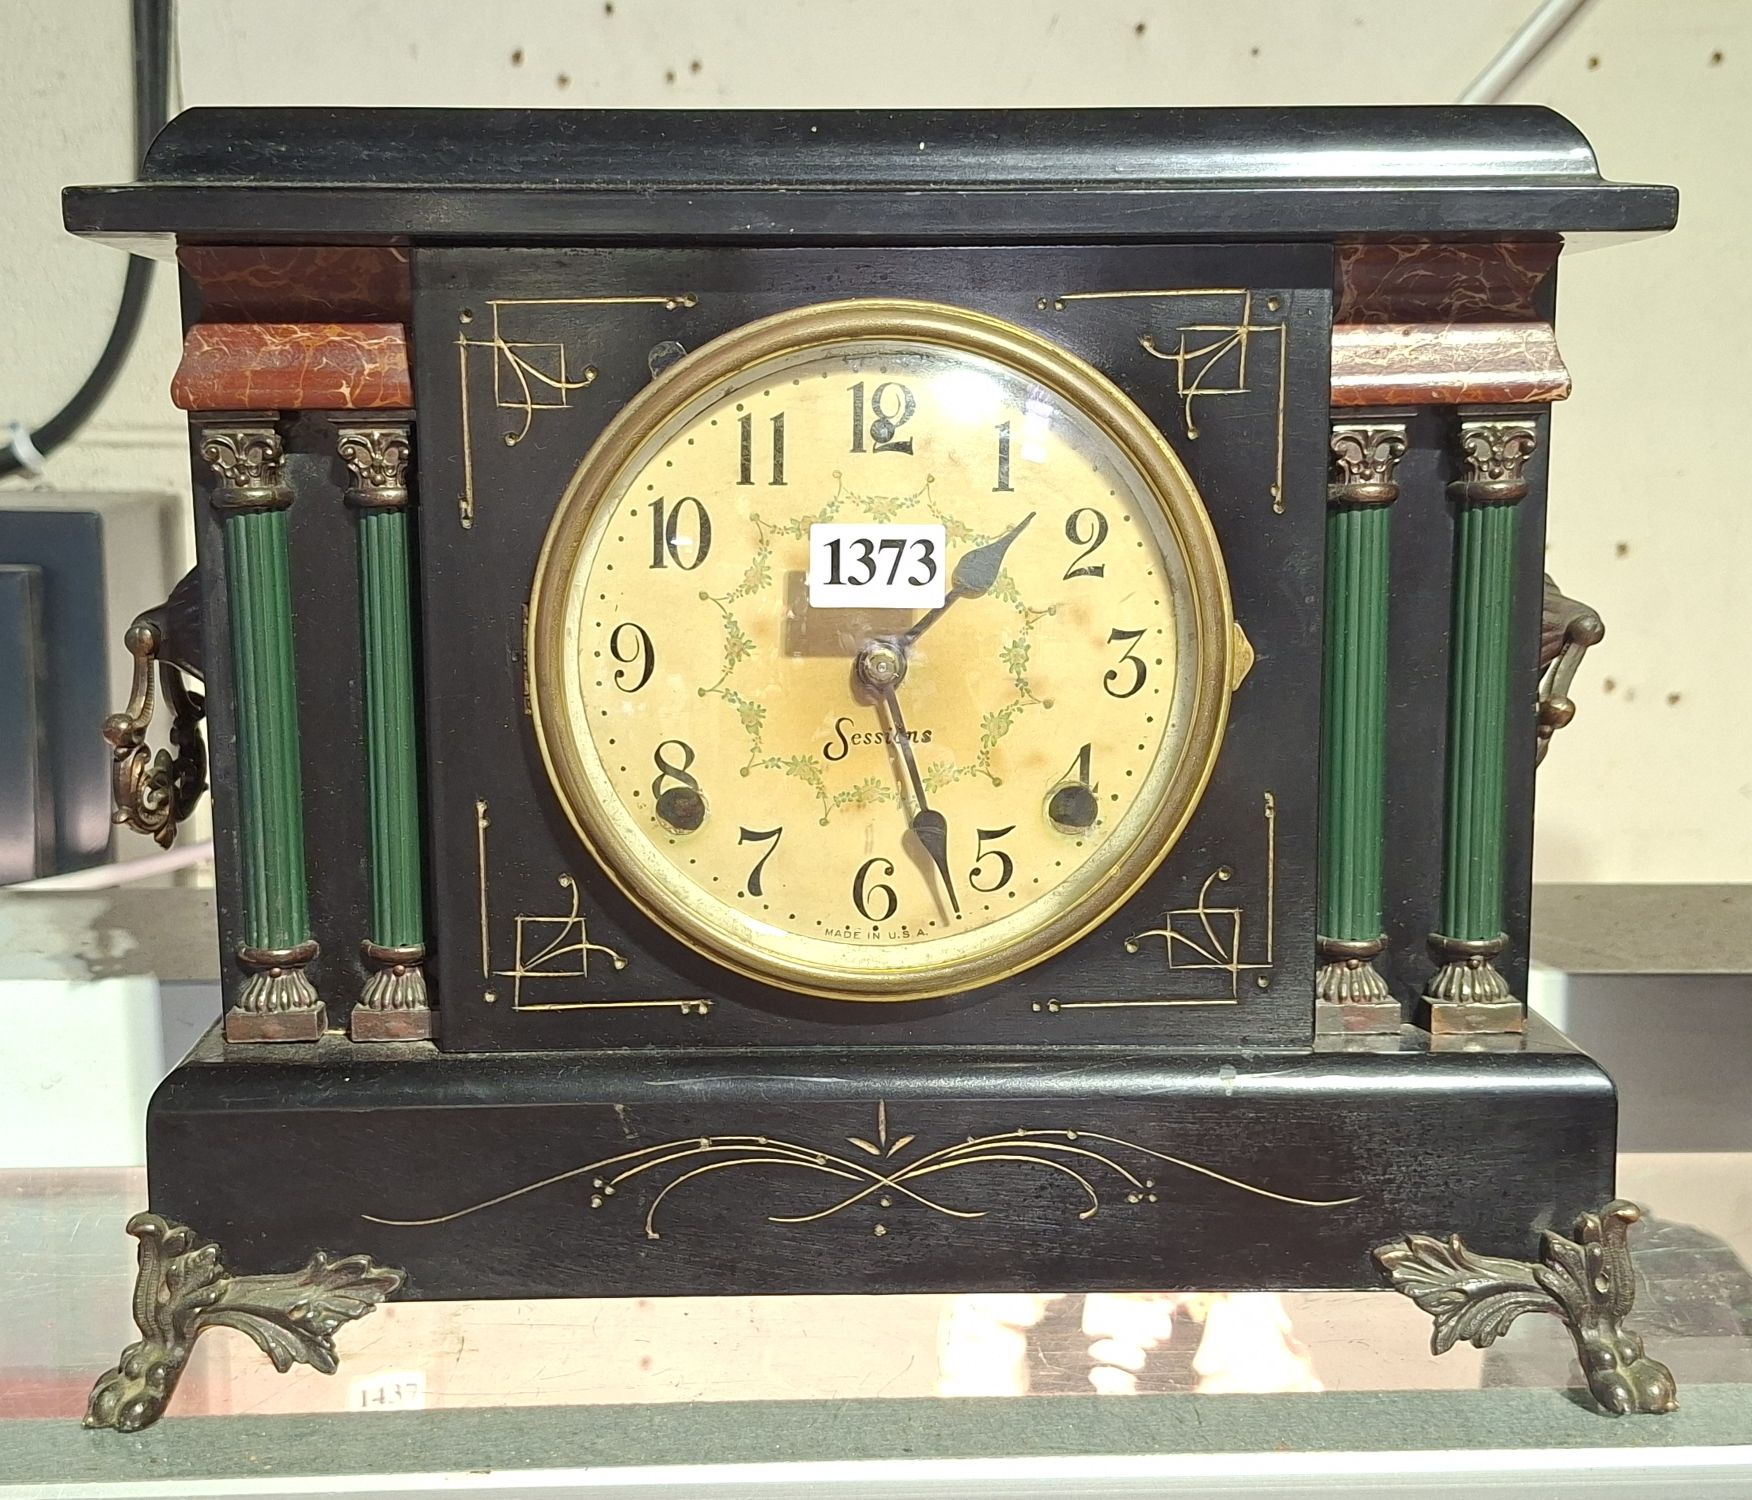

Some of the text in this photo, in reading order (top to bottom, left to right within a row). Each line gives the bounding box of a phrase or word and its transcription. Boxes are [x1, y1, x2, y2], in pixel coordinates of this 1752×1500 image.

[736, 412, 788, 486] 11
[847, 381, 917, 456] 12
[992, 420, 1015, 493] 1
[647, 496, 712, 570] 10
[823, 538, 938, 587] 1373
[1063, 507, 1109, 581] 2
[610, 622, 655, 693] 9
[1103, 627, 1149, 698] 3
[737, 826, 784, 897] 7
[852, 857, 898, 921] 6
[969, 825, 1016, 893] 5
[824, 927, 862, 940] MADE
[867, 932, 881, 940] IN
